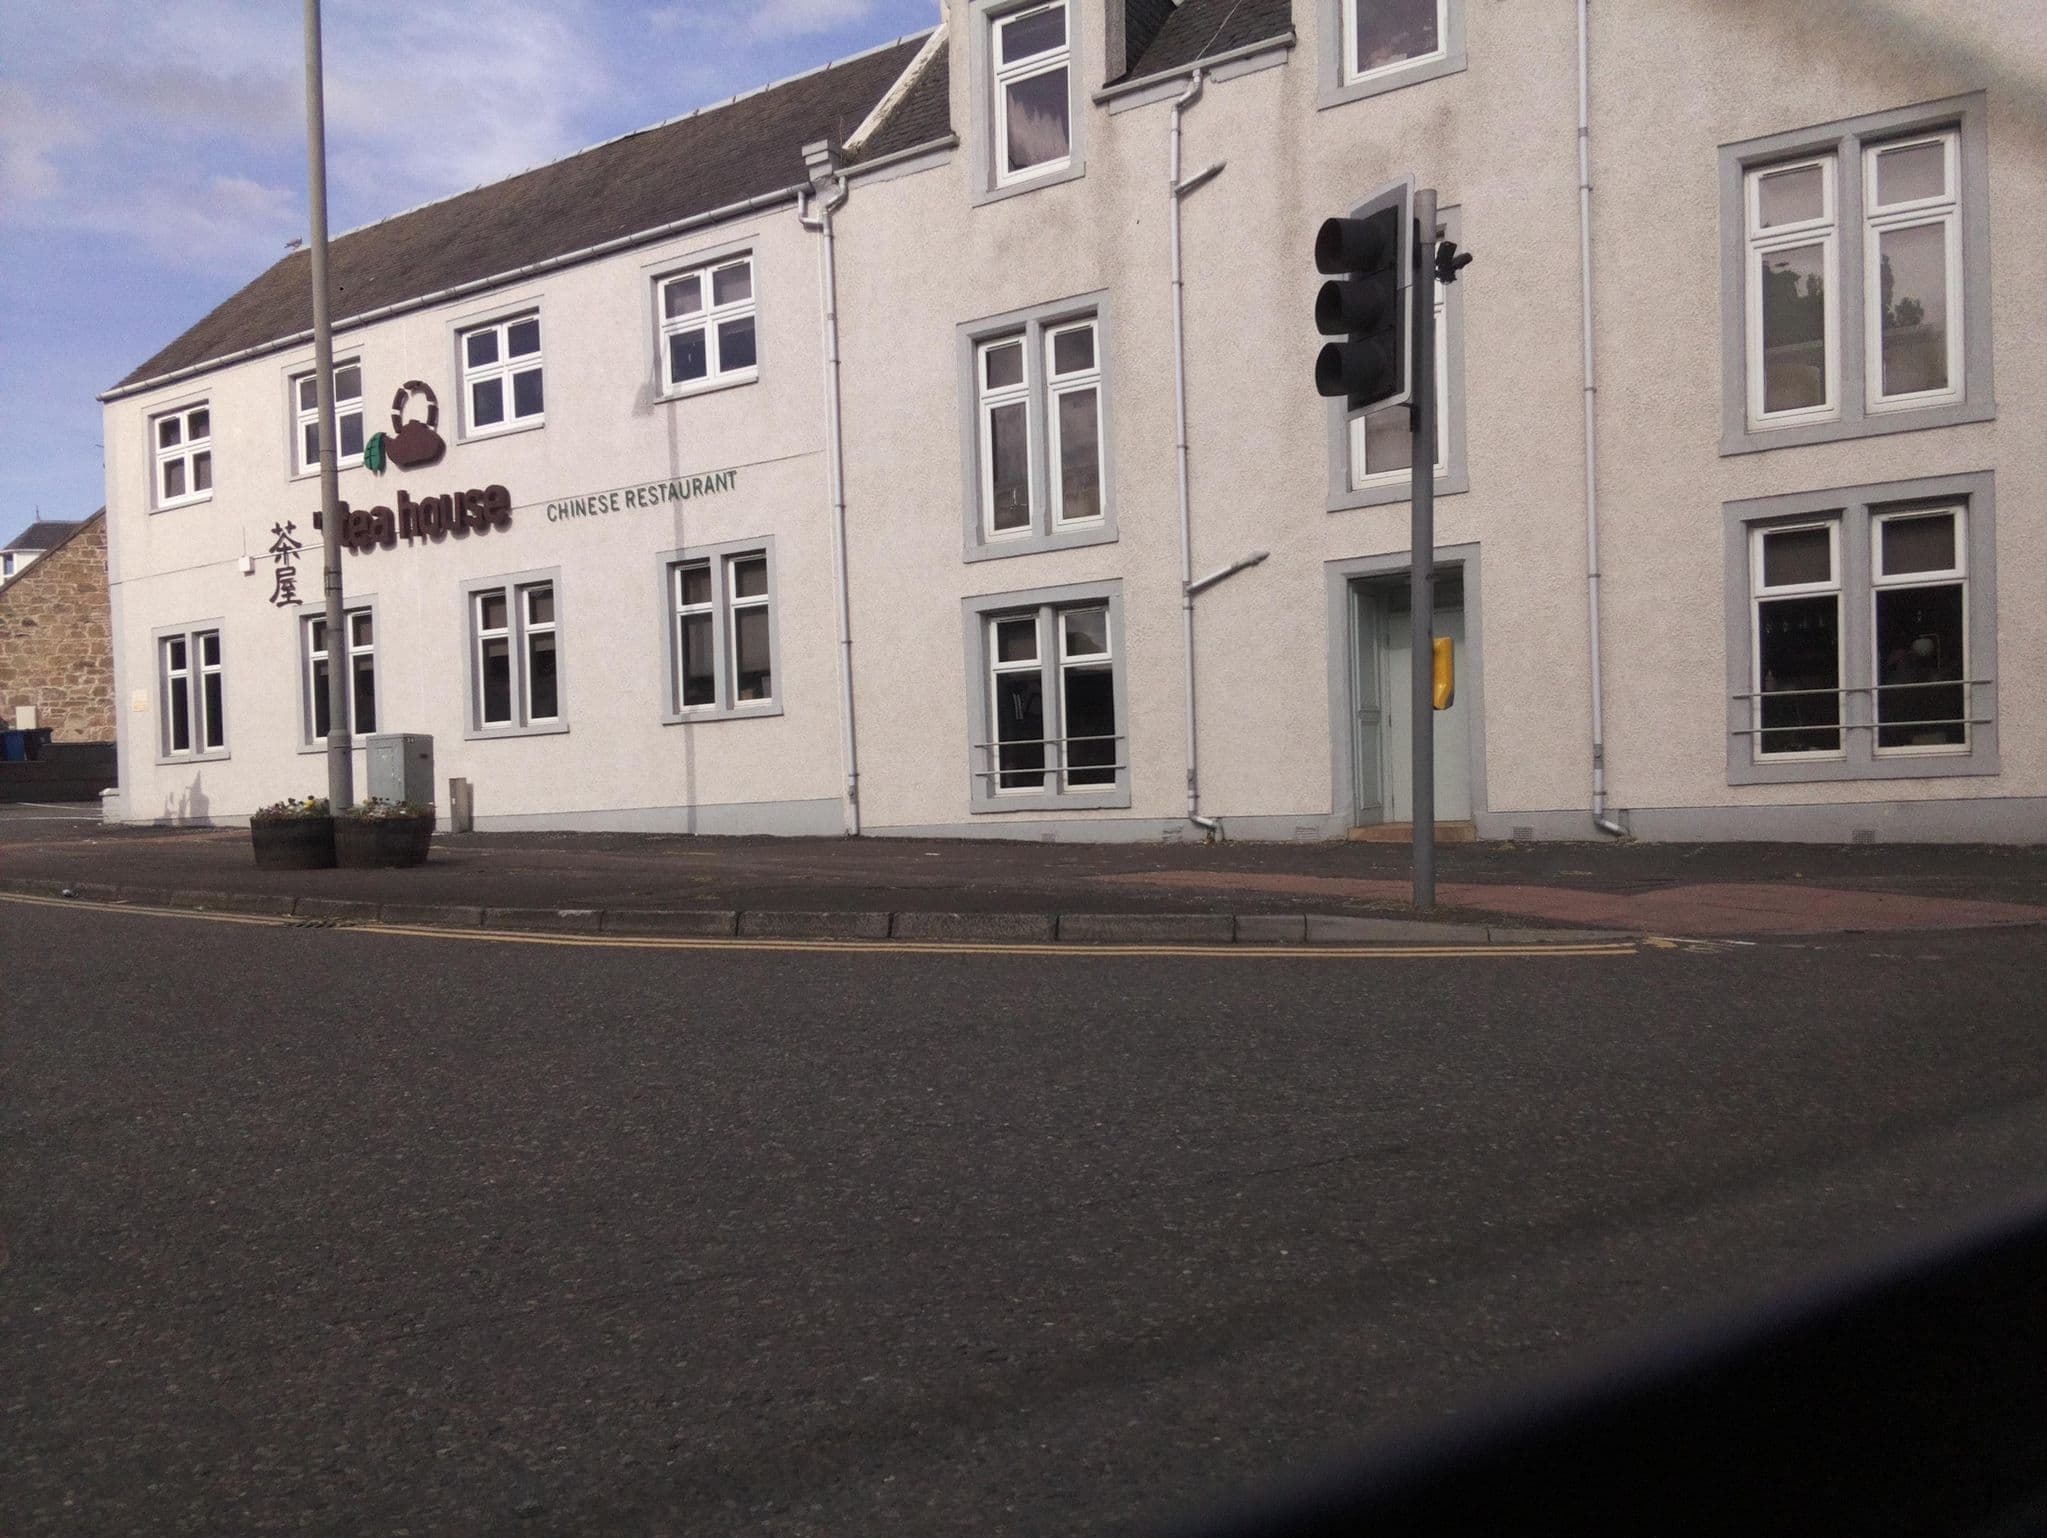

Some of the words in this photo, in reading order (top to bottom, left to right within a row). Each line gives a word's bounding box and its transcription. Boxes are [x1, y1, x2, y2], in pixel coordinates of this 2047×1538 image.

[397, 485, 511, 541] house
[547, 493, 620, 522] CHINESE
[626, 470, 737, 509] RESTAURANT
[269, 520, 303, 608] 茶屋
